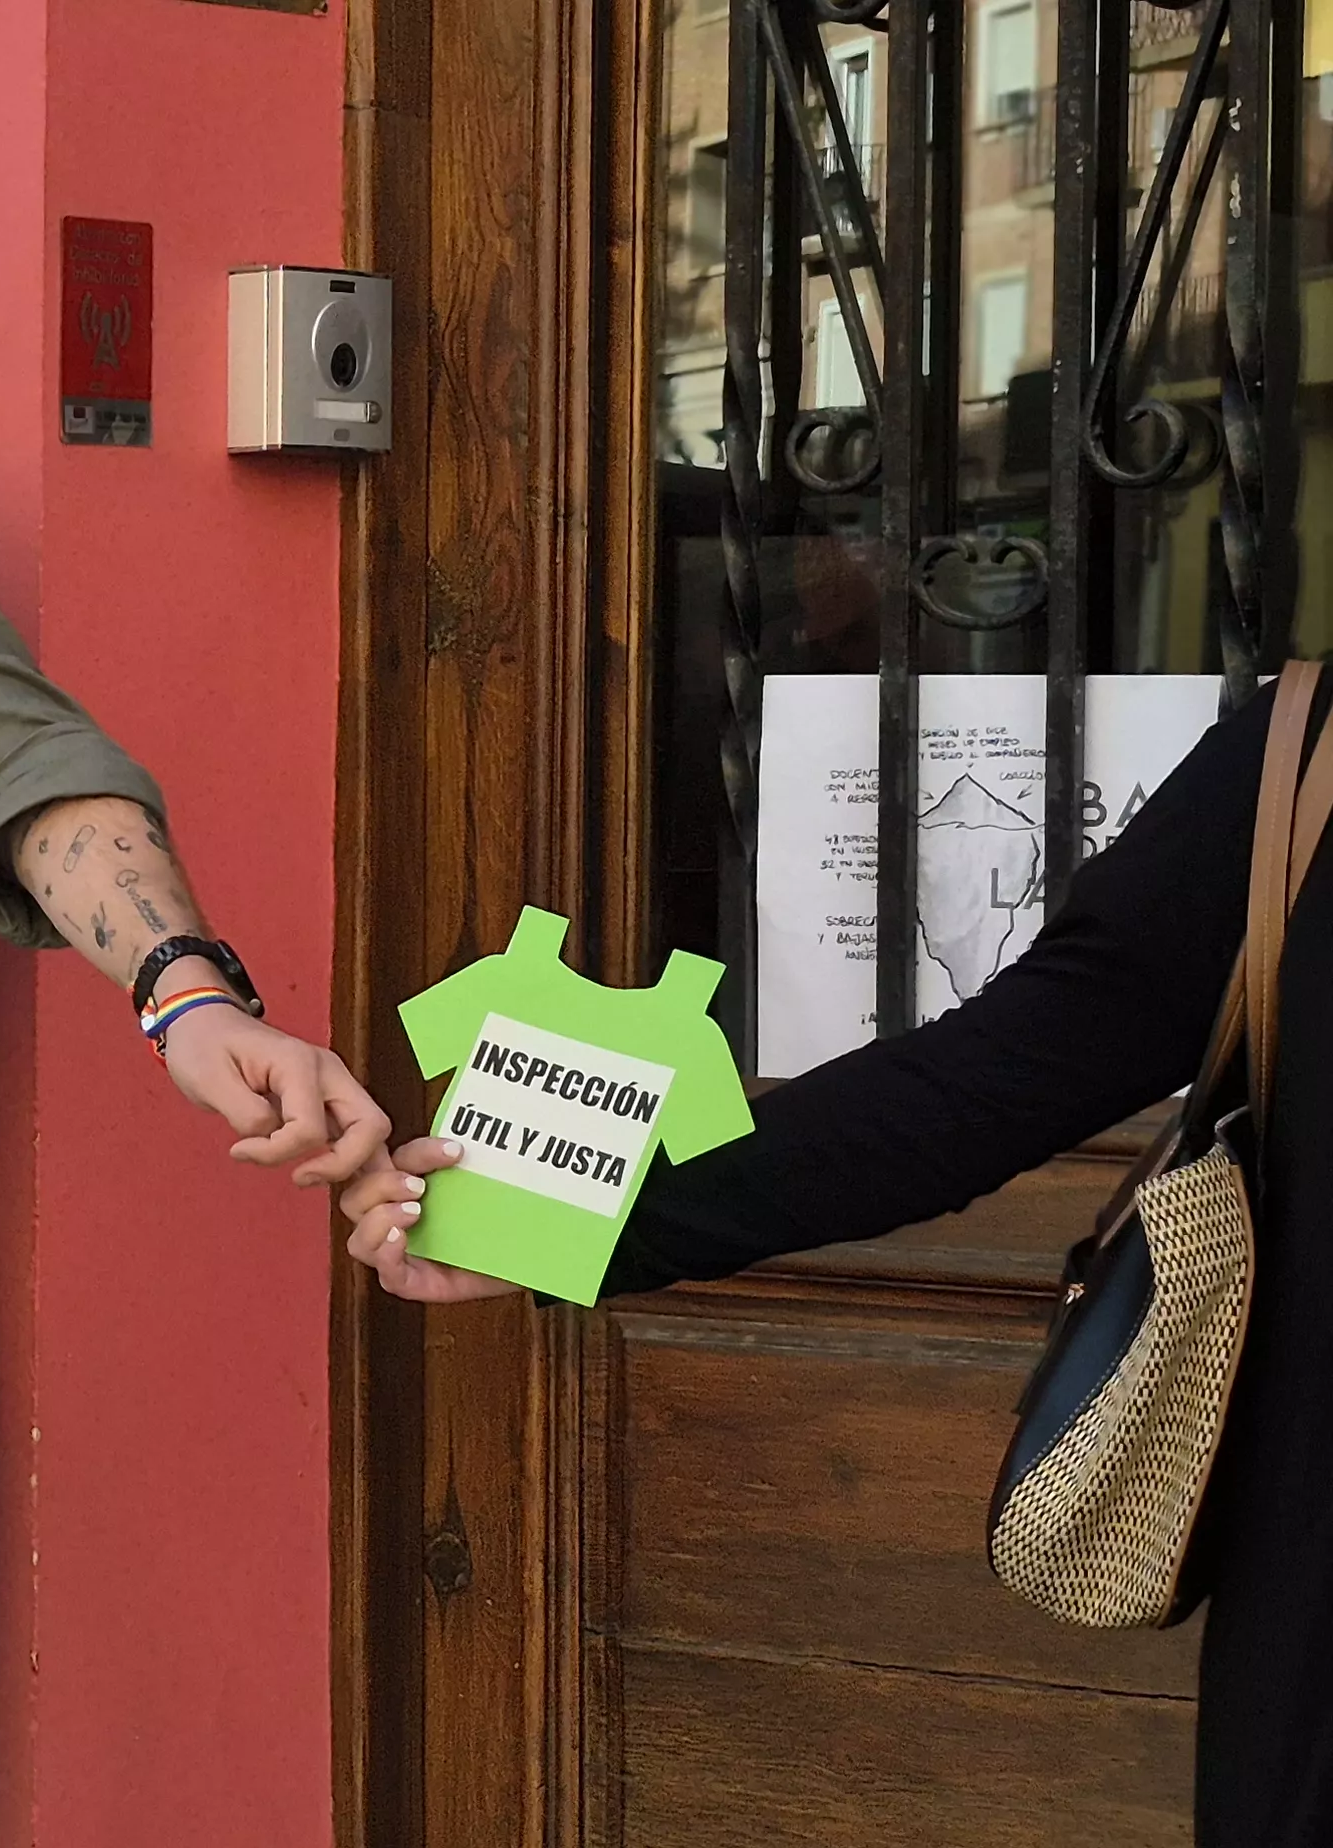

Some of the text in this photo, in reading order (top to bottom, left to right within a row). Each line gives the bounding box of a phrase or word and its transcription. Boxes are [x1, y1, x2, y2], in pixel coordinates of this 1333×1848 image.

[830, 769, 879, 779] DOCENT
[856, 782, 879, 790] MIE
[836, 932, 876, 946] BAJAS
[471, 1039, 660, 1124] INSPECCIÓN
[450, 1103, 627, 1187] ÚTIL Y JUSTA
